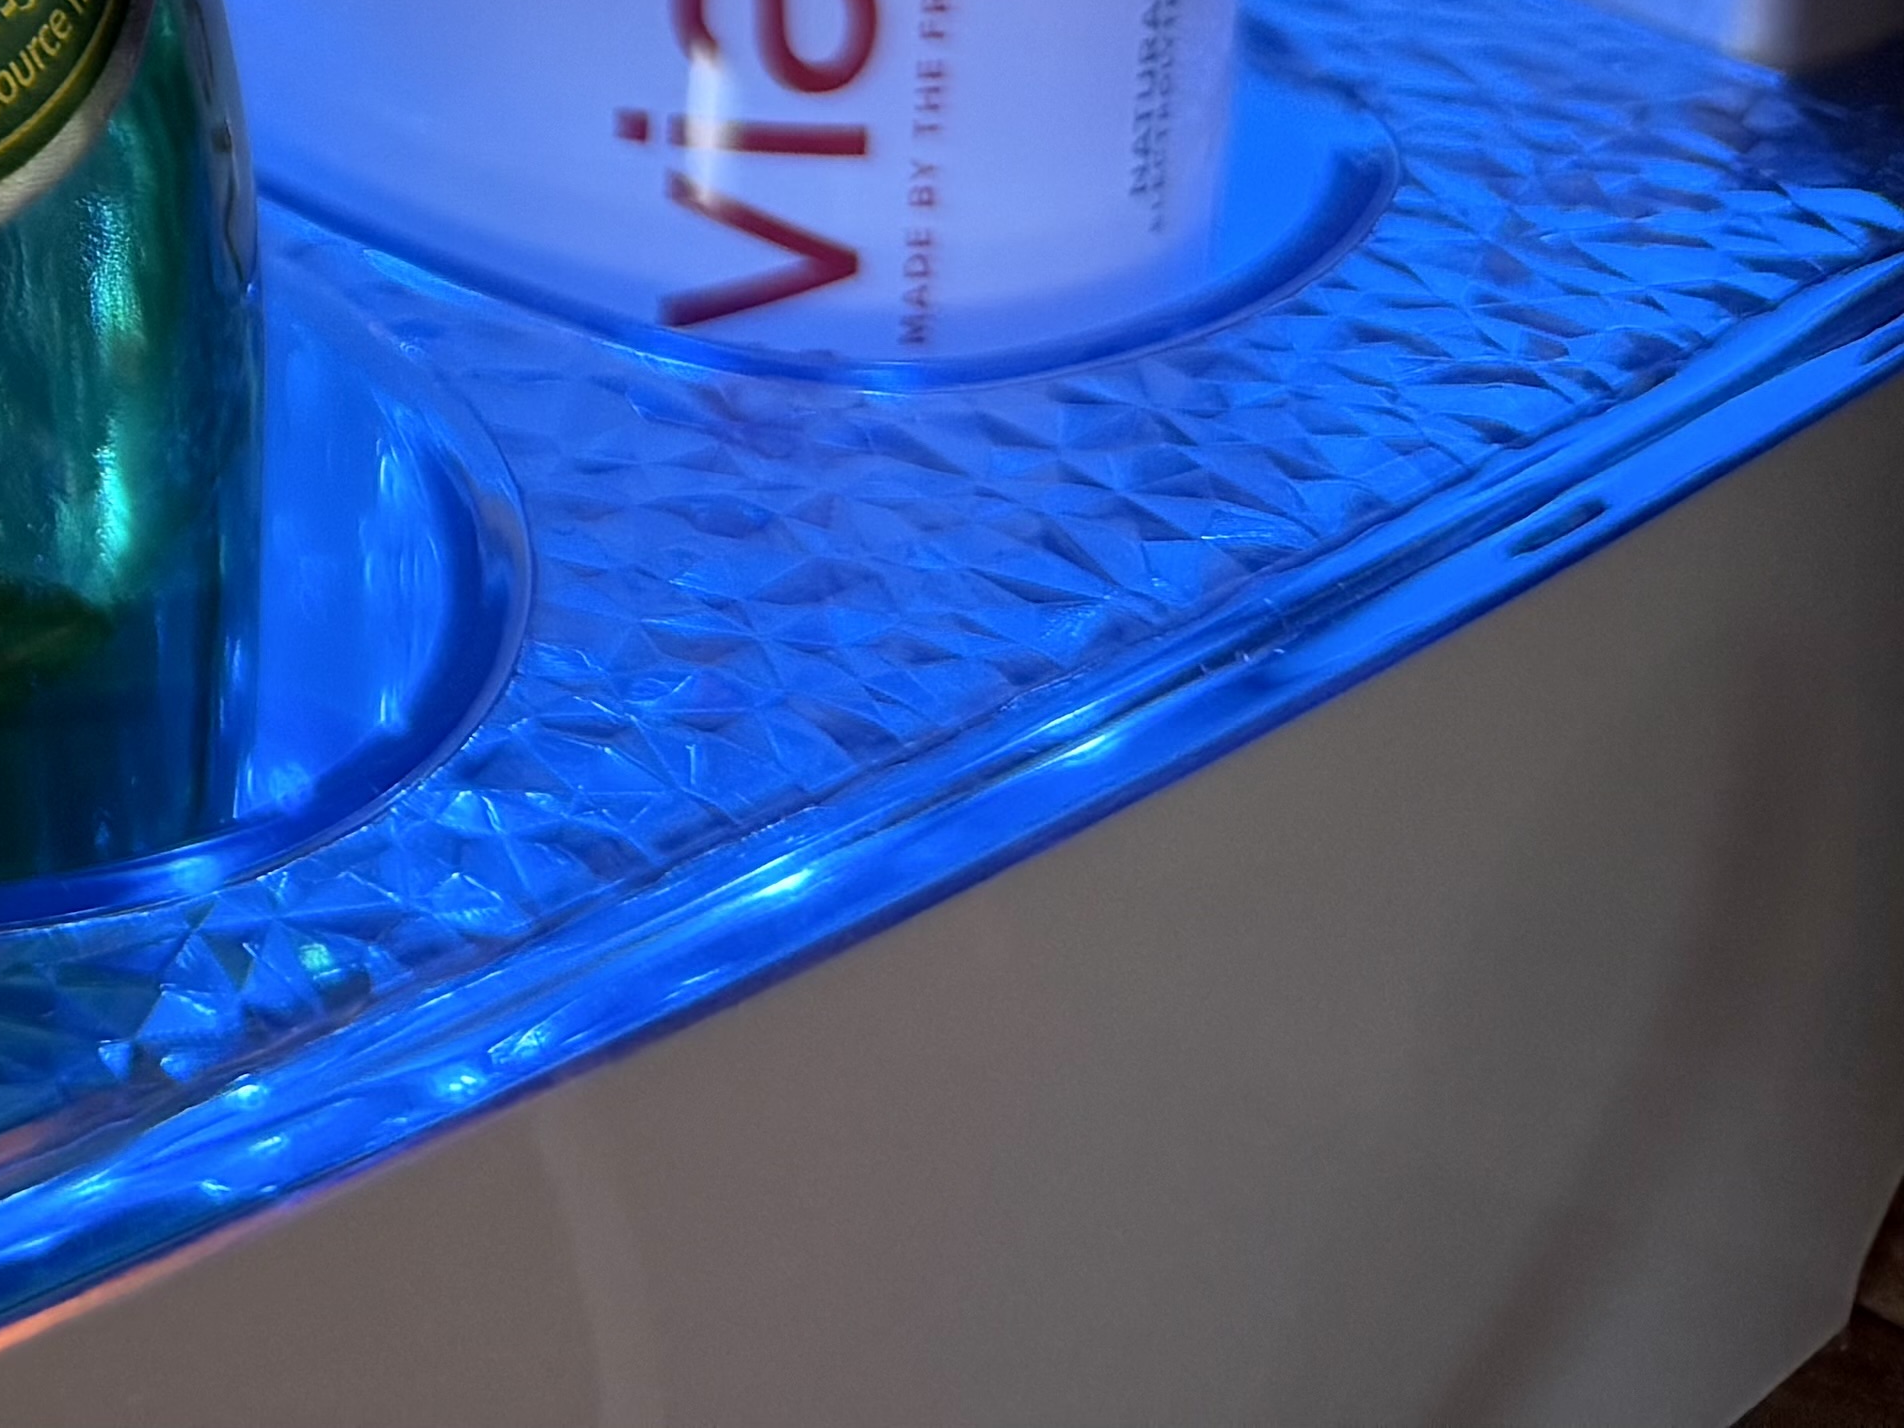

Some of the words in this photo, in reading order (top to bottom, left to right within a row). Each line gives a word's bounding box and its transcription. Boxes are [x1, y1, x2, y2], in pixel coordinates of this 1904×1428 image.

[911, 57, 955, 137] THE
[905, 159, 940, 212] BY
[896, 227, 937, 347] MADE
